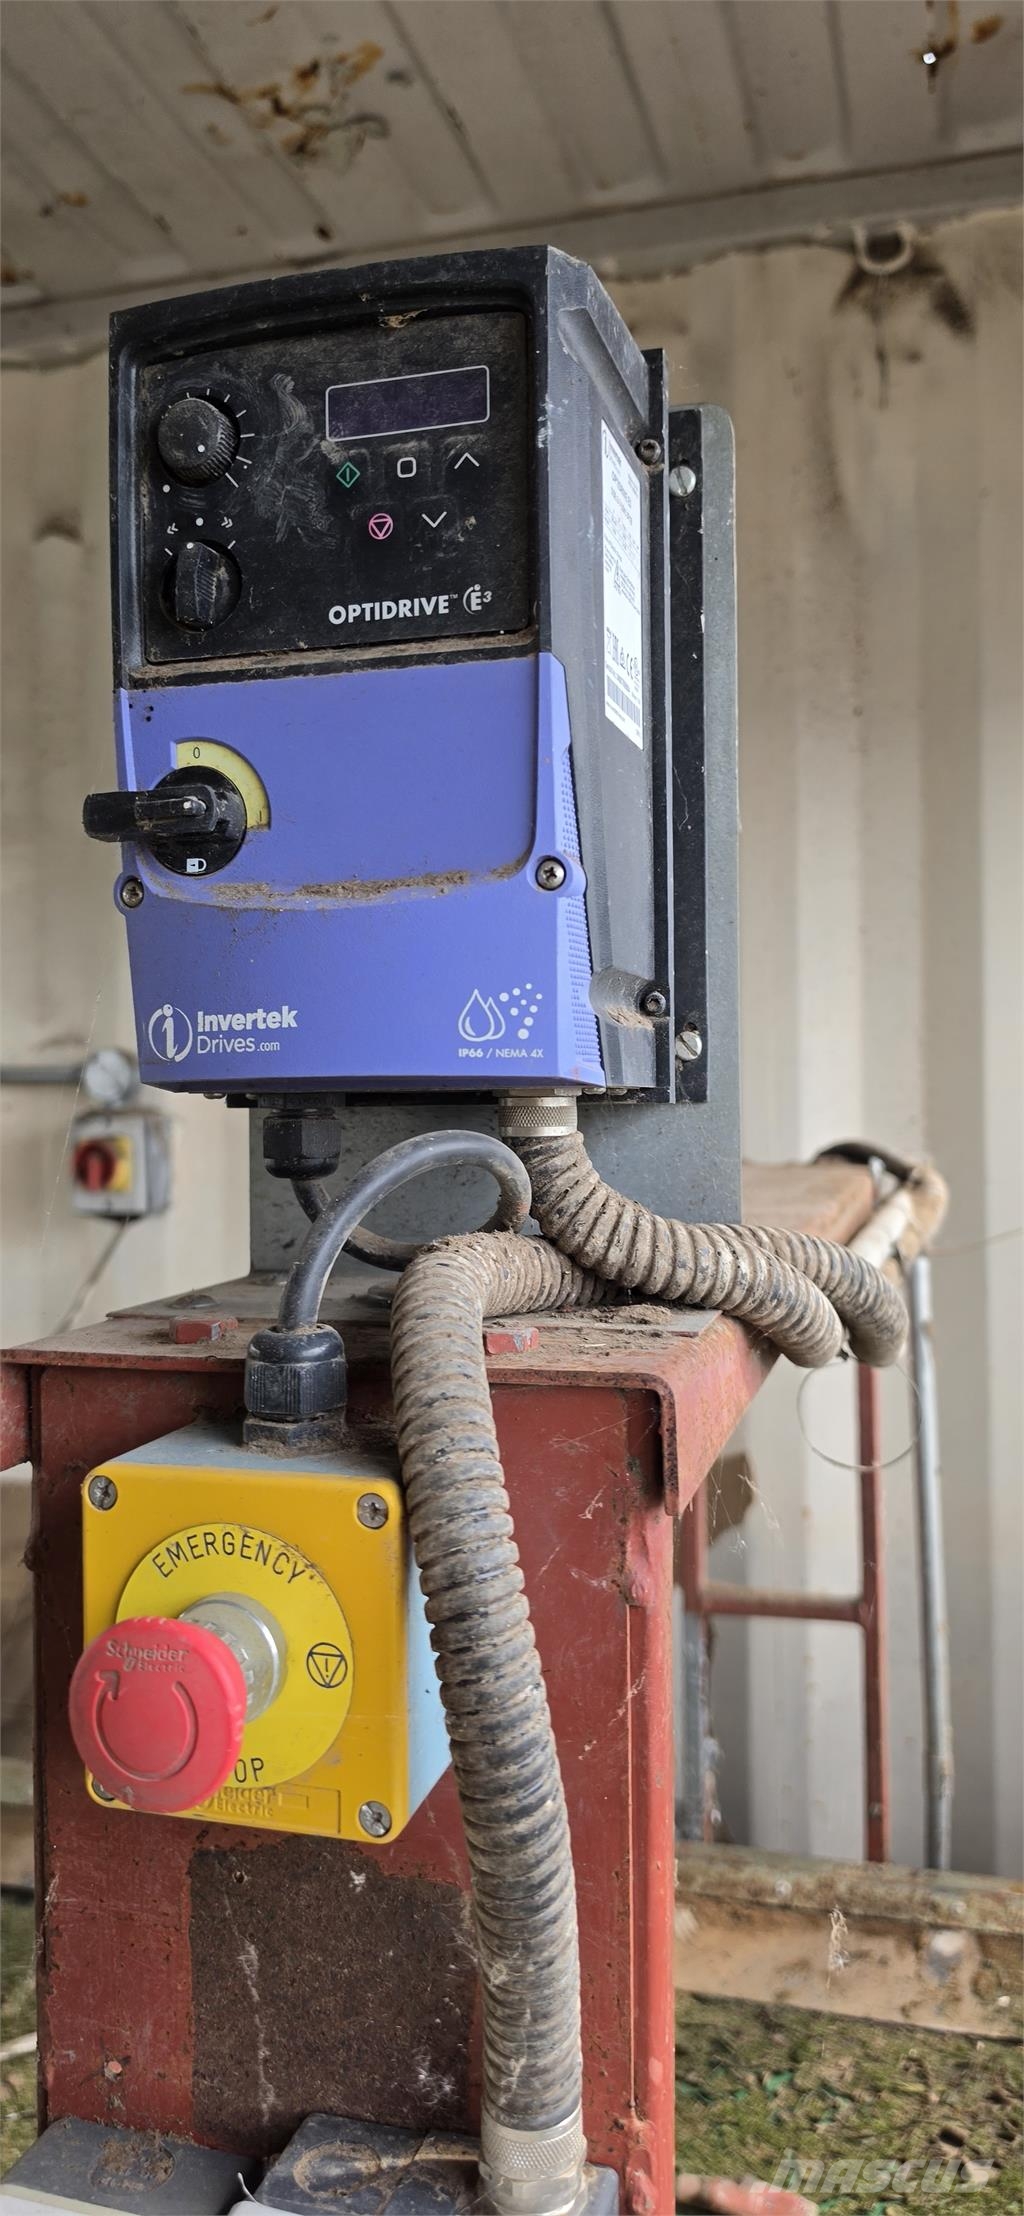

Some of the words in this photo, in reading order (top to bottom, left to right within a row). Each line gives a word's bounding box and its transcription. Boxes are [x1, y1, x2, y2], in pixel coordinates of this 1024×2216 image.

[197, 1005, 298, 1033] Invertek
[458, 1047, 484, 1058] IP66
[495, 1047, 528, 1058] NEMA
[529, 1047, 545, 1058] 4X
[152, 1531, 306, 1584] EMERGENCY
[106, 1639, 189, 1662] Schneider
[234, 1757, 264, 1783] OP
